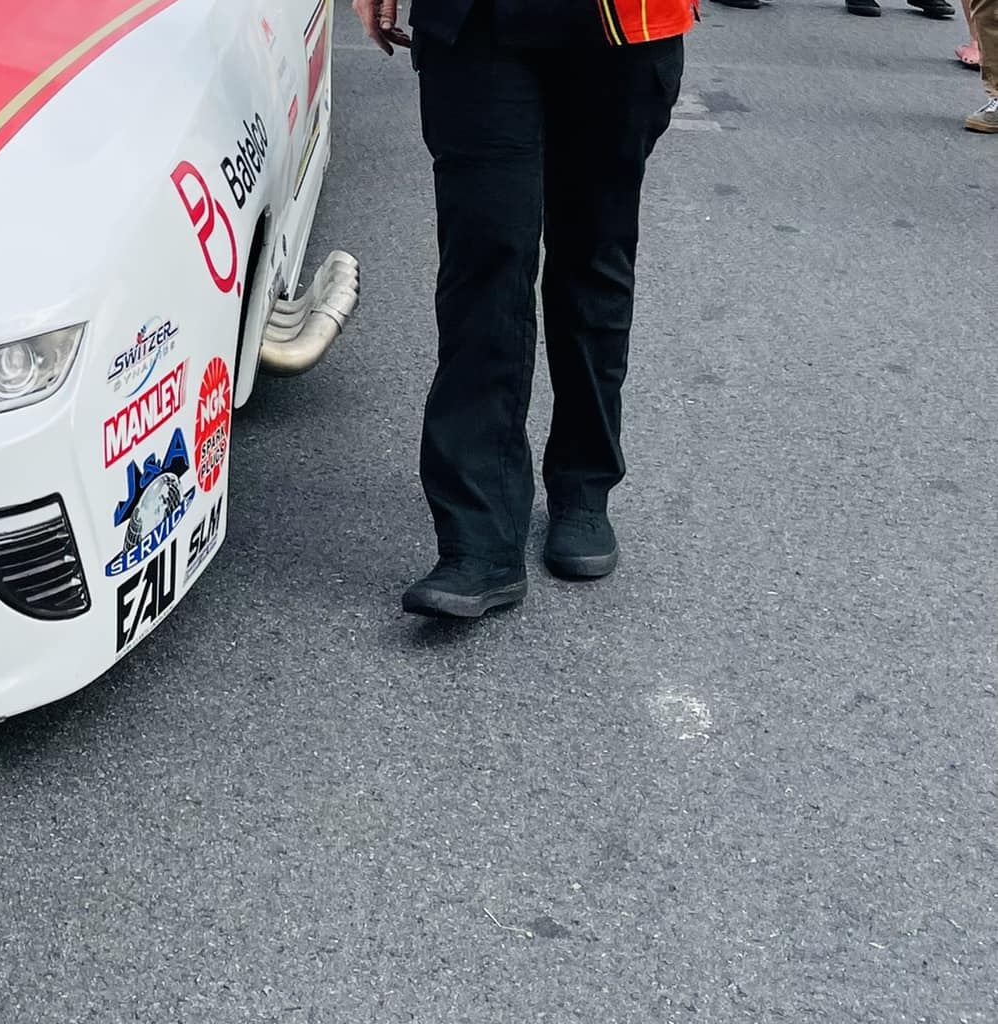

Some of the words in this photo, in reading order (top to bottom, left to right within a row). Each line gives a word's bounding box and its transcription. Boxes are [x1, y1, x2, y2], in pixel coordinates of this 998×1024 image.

[220, 112, 268, 211] Batelco
[104, 363, 185, 468] MANLEY
[200, 378, 226, 433] NGK
[201, 425, 224, 459] SPARK
[114, 426, 190, 528] J&A
[201, 445, 224, 476] PLUGS
[108, 488, 195, 575] SERVICE
[186, 494, 223, 568] SLM
